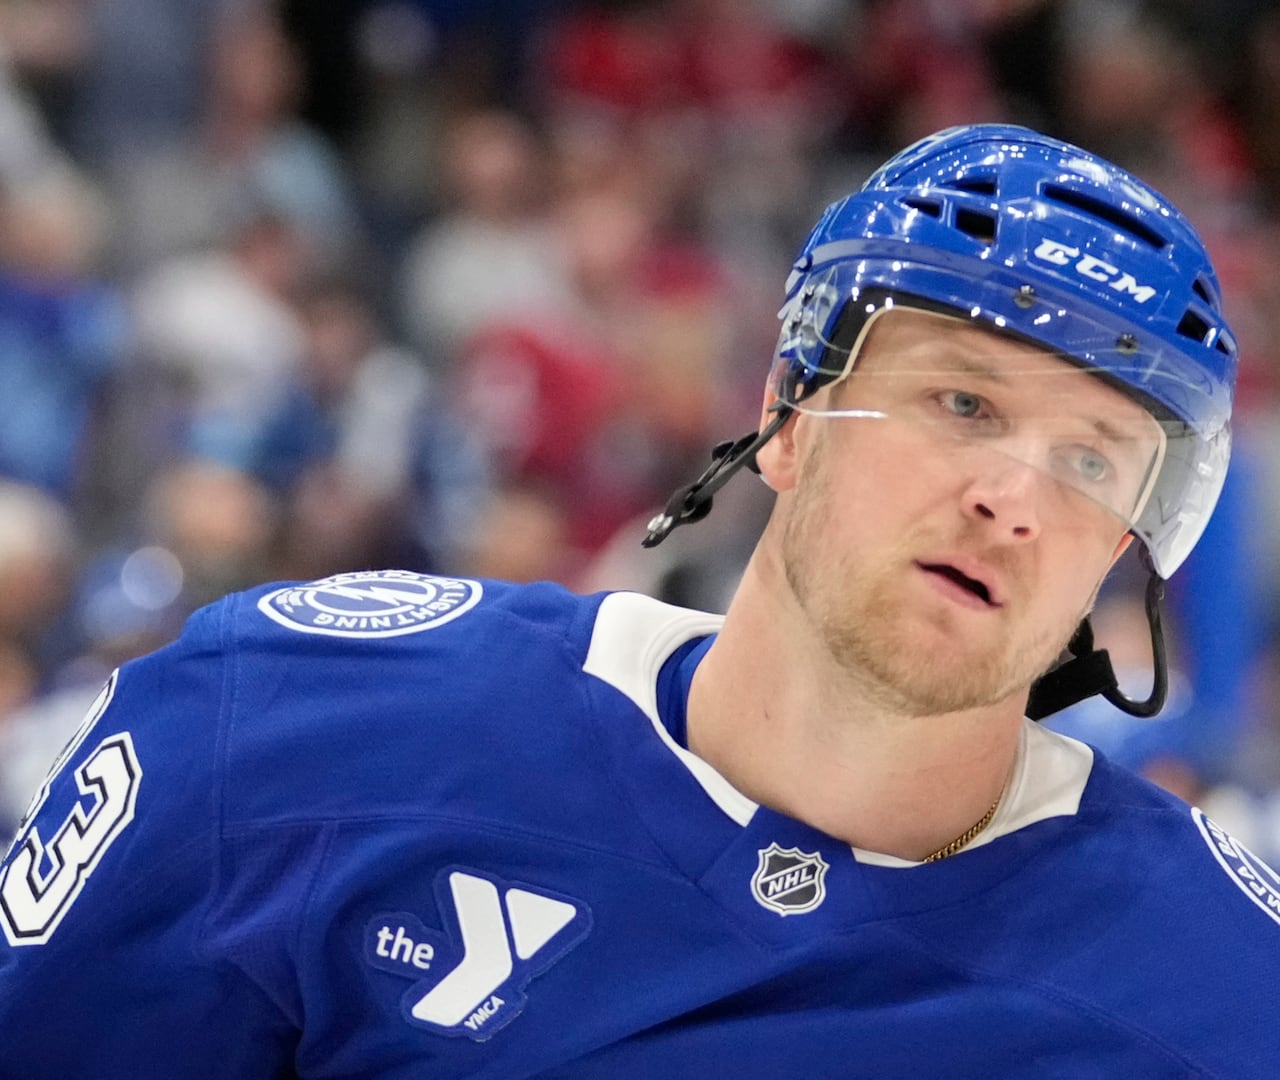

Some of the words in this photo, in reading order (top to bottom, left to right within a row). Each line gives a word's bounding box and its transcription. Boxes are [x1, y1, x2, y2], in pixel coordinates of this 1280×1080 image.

[1033, 237, 1157, 304] CCM
[311, 587, 466, 629] LIGHTNING
[767, 866, 814, 897] NHL
[376, 925, 435, 970] the
[464, 995, 505, 1031] YMCA
